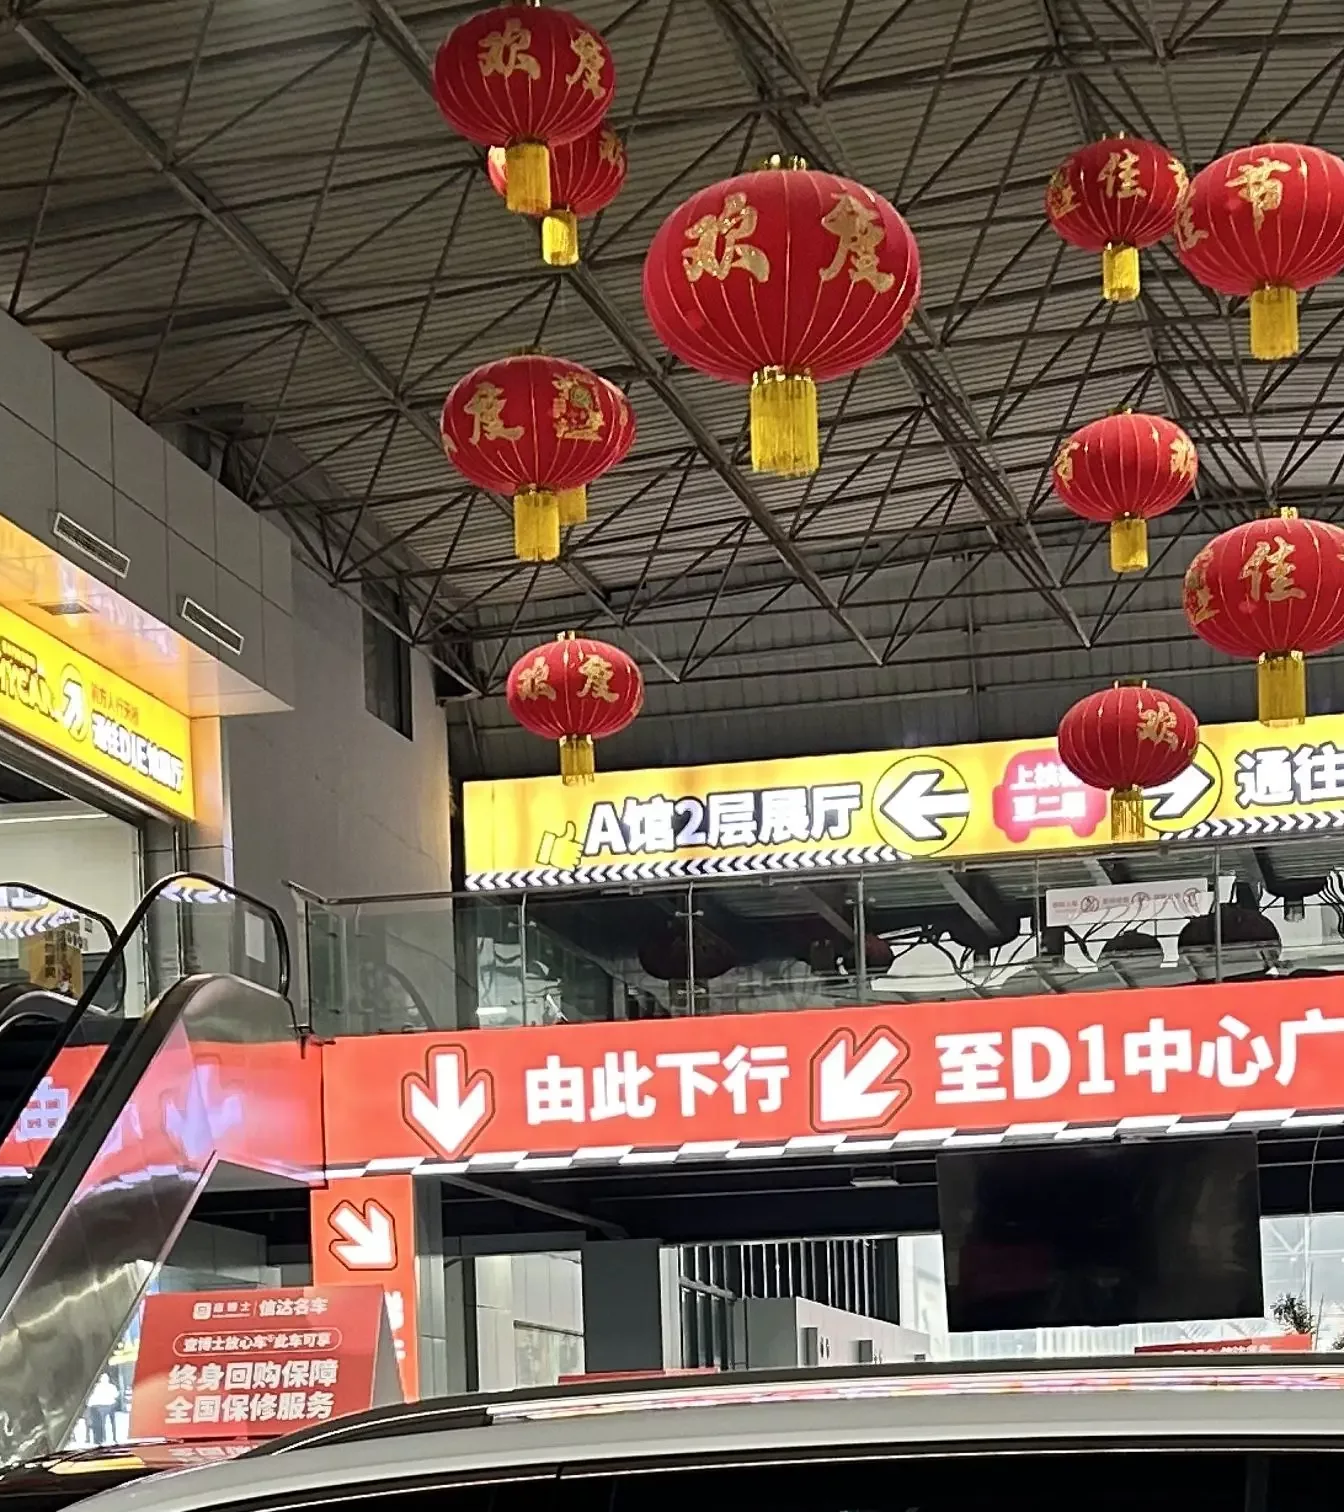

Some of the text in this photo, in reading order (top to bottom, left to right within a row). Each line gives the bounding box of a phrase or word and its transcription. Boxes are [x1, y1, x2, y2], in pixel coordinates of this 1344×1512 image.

[581, 782, 864, 857] A馆2层展厅
[524, 1043, 790, 1126] 由此下行
[167, 1358, 339, 1392] 终身回购保障
[164, 1391, 335, 1424] 全国保修服务
